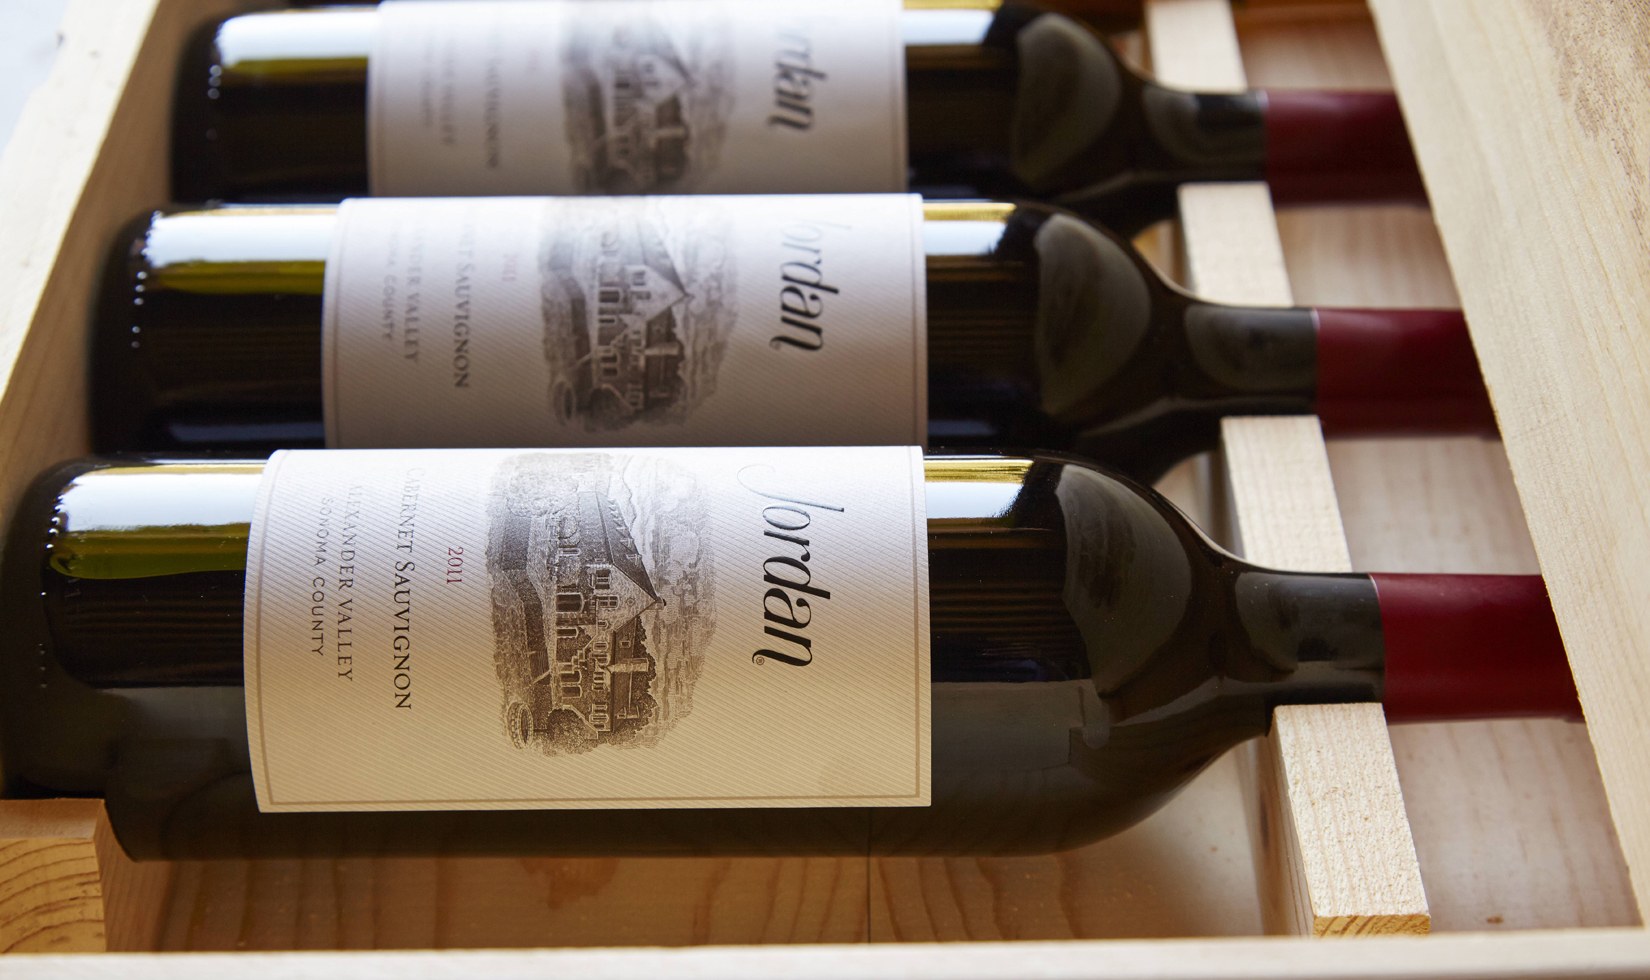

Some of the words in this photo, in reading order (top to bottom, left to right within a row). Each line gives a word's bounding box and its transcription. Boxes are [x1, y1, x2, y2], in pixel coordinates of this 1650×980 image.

[453, 263, 475, 387] SAUVIGNON
[314, 497, 334, 566] SONOMA
[396, 467, 426, 553] CABERNET
[447, 546, 464, 585] 2011
[311, 577, 326, 656] COUNTY
[337, 598, 353, 681] VALLEY
[393, 561, 415, 709] SAUVIGNON
